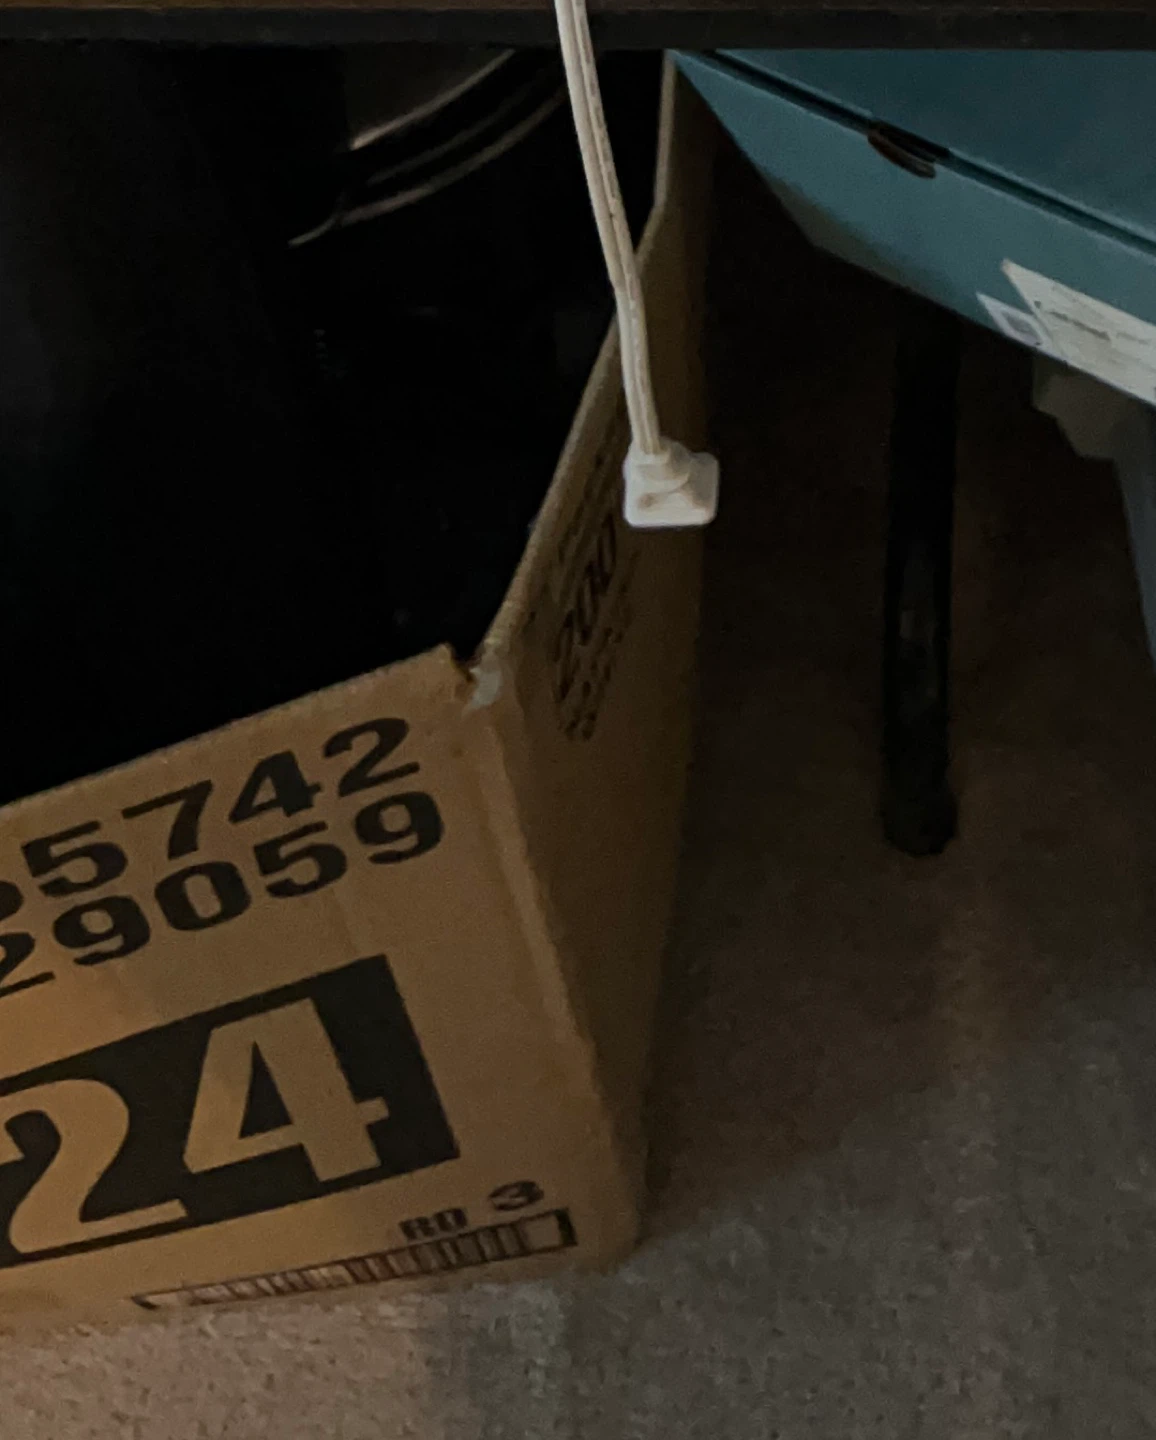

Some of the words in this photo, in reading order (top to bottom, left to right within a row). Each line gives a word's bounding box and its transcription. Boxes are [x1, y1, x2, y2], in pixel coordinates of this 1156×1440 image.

[0, 717, 420, 924] 5742
[0, 996, 390, 1256] 24
[489, 1180, 545, 1211] 3
